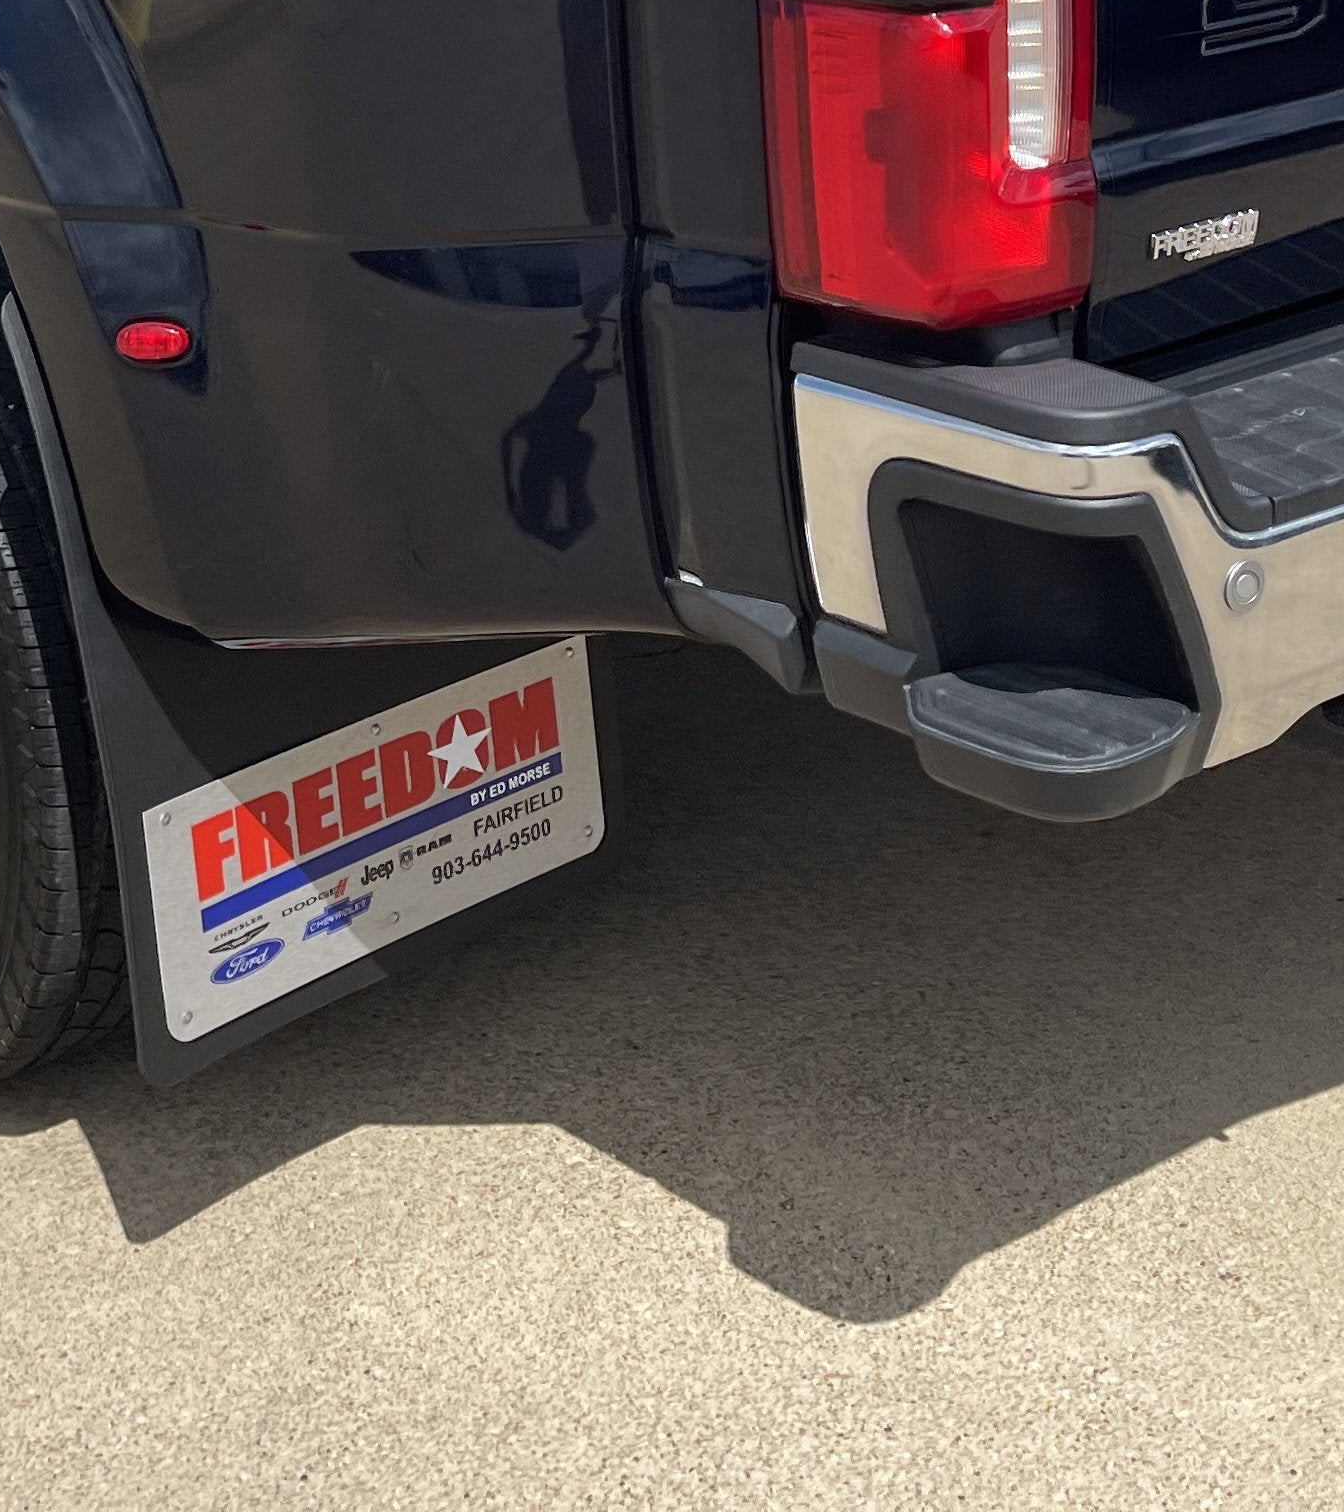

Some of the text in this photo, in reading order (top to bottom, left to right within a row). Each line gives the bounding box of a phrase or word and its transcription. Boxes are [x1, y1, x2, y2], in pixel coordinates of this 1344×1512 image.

[190, 676, 561, 903] FREEDOM
[469, 761, 552, 807] BY ED MORSE
[472, 785, 564, 838] FAIRFIELD
[360, 833, 453, 886] Jeep RAM
[431, 818, 552, 885] 903-644-9500
[281, 886, 338, 918] DODGE
[213, 914, 264, 942] CHRYSLER
[225, 946, 270, 979] Ford
